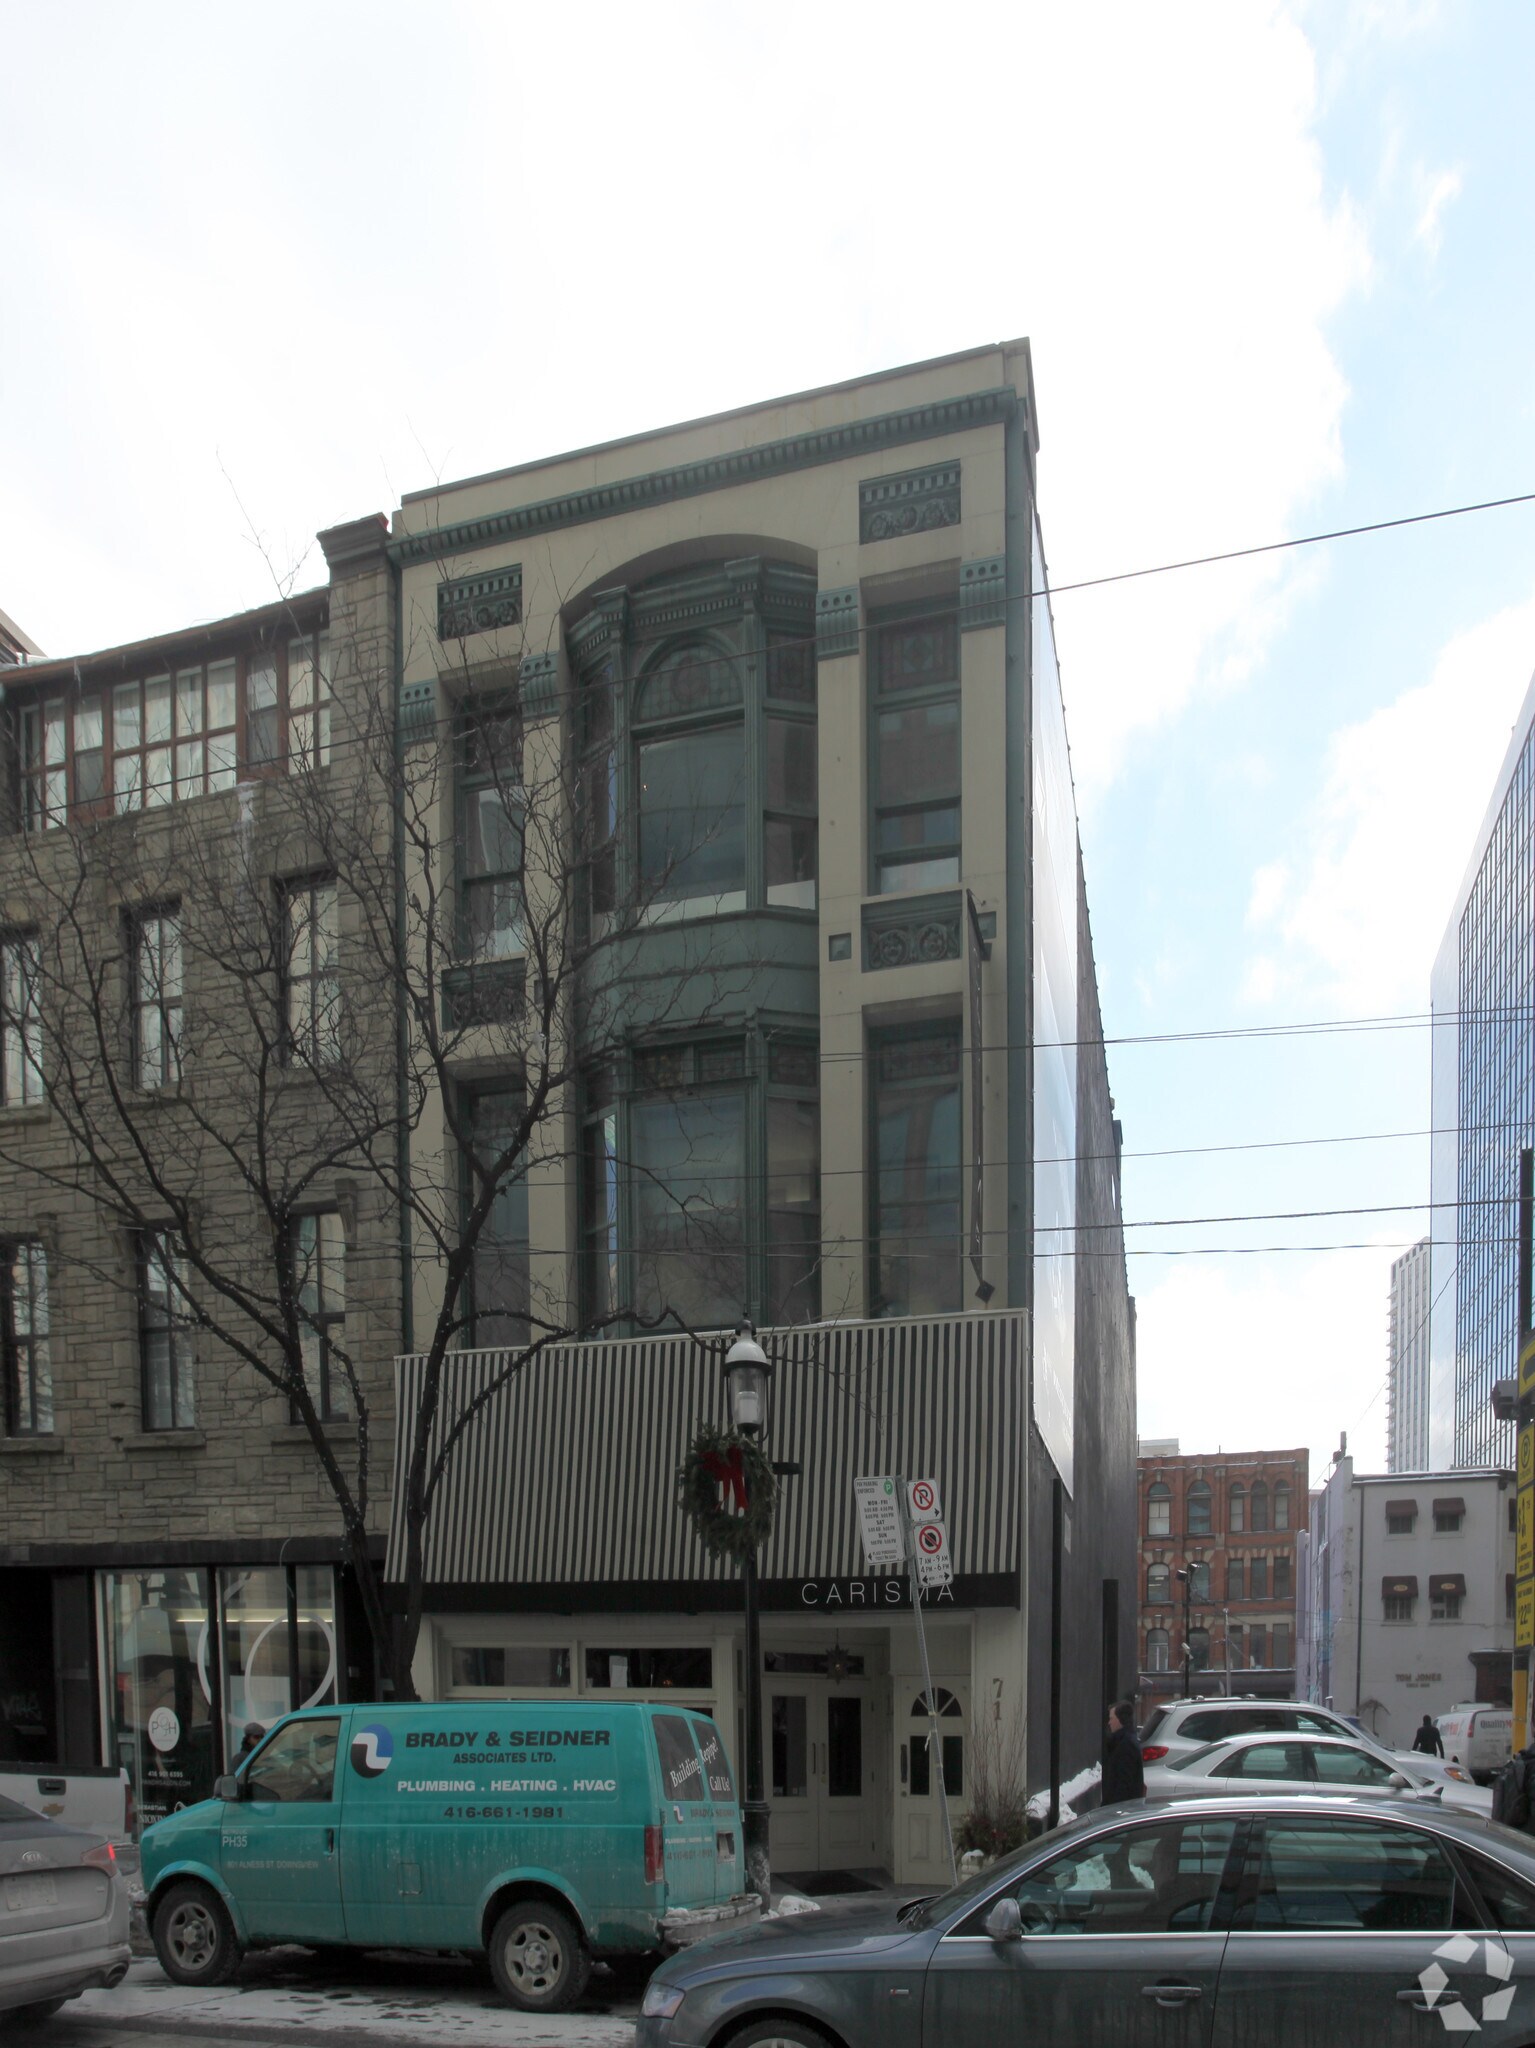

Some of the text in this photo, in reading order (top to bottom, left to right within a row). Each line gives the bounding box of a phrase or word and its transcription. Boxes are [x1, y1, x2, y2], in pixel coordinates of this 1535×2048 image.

[802, 1581, 954, 1605] CARISMA
[1395, 1672, 1442, 1682] TOM JONES
[405, 1730, 611, 1748] BRADY & SEIDNER
[453, 1752, 557, 1764] ASSOCIATES LTD.
[670, 1758, 702, 1788] Building
[397, 1780, 475, 1792] PLUMBING
[490, 1779, 557, 1791] HEATING
[573, 1779, 617, 1791] HVAC
[708, 1775, 720, 1791] Call
[443, 1806, 564, 1819] 416-661-1981
[222, 1835, 248, 1848] PH35
